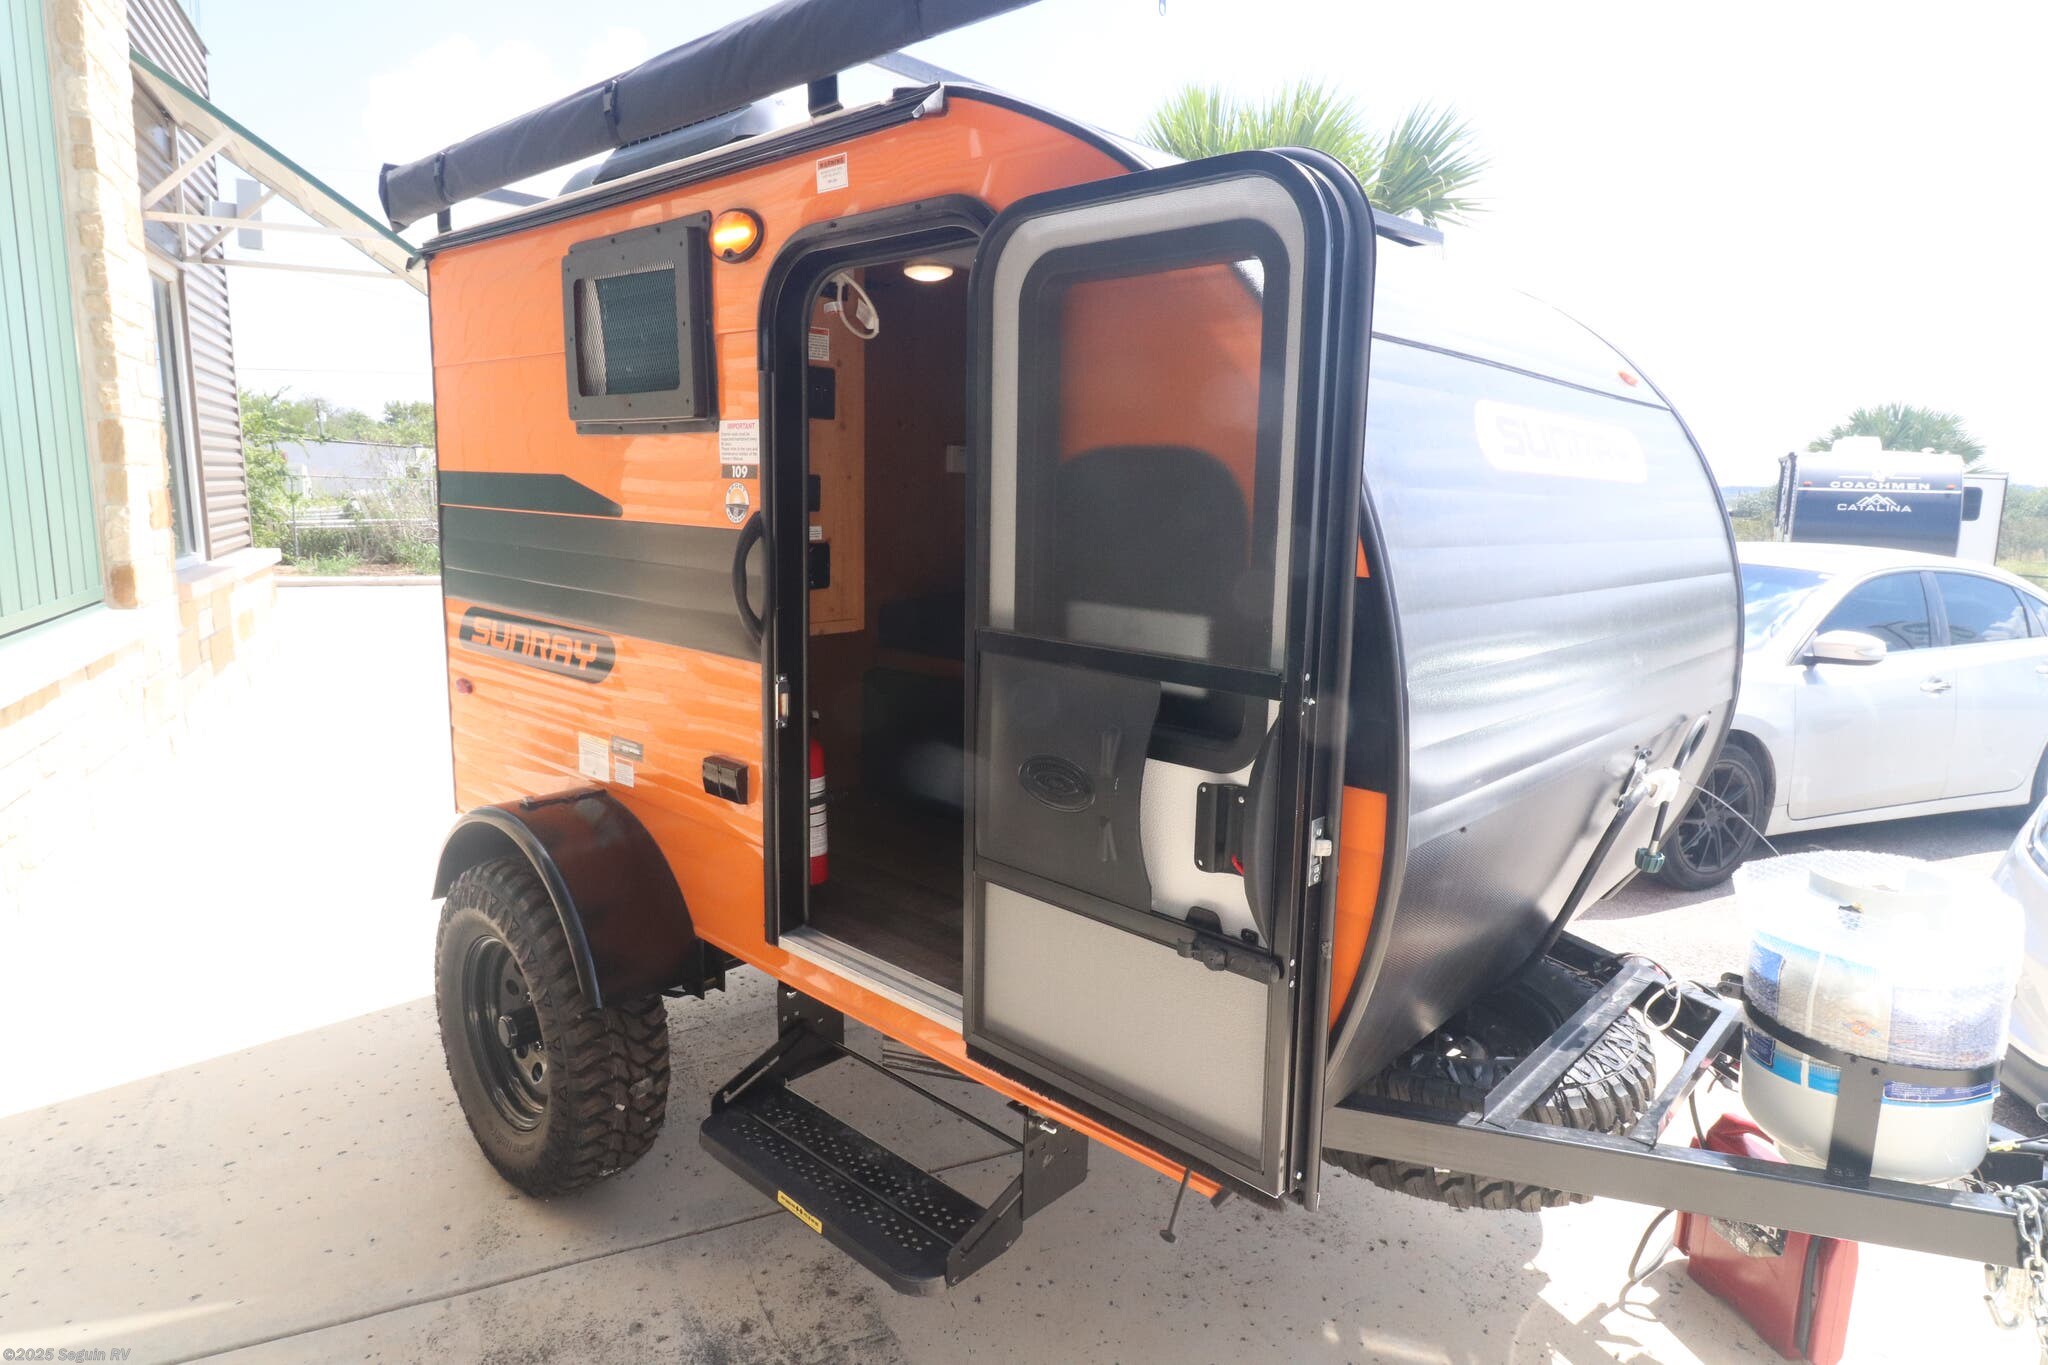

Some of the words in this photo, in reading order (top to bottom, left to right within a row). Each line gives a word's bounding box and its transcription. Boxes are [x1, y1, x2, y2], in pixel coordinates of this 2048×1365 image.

[727, 422, 756, 430] IMPORTANT
[731, 465, 749, 478] 109
[1829, 480, 1931, 490] COACHMEN
[1837, 503, 1912, 513] CATALINA
[471, 616, 598, 670] SUNRAY
